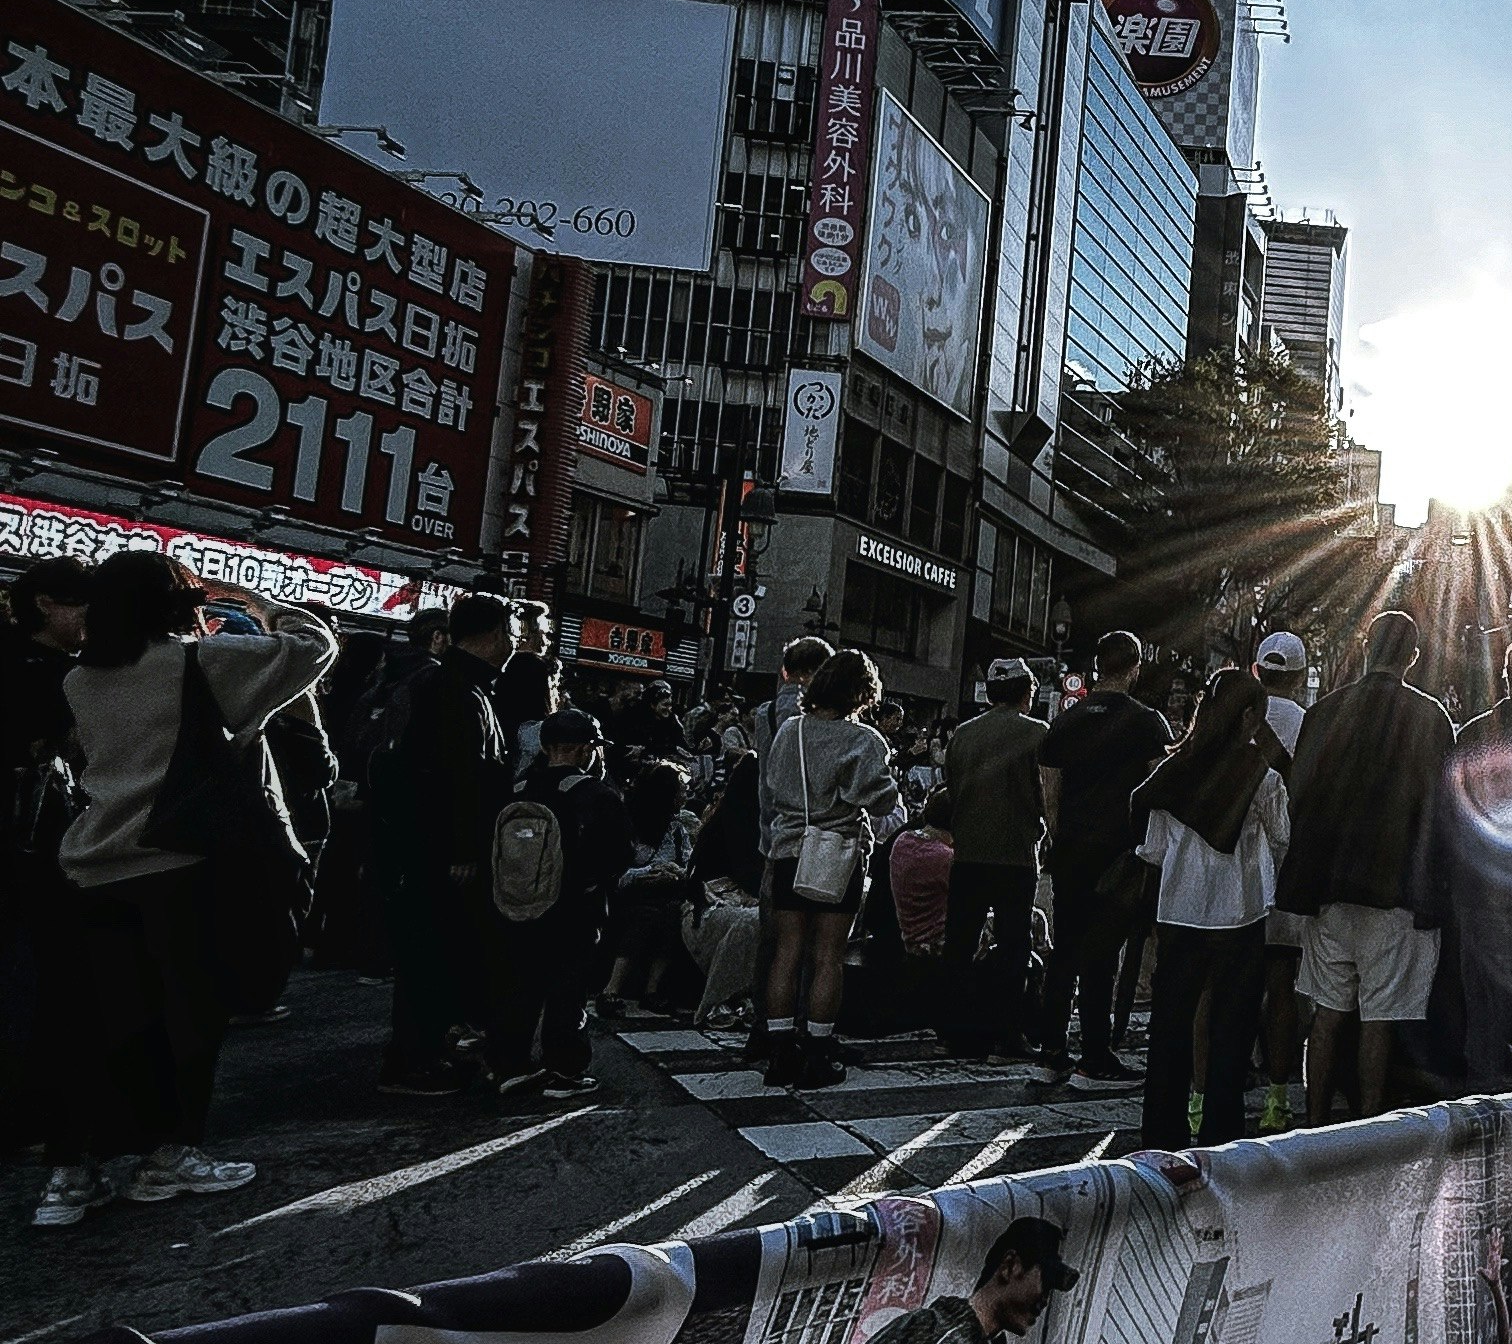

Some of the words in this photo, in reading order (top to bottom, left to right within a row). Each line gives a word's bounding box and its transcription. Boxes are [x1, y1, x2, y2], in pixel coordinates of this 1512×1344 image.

[1114, 12, 1201, 58] 楽園
[1142, 56, 1212, 98] AMUSEMENT
[820, 17, 866, 216] 品川美容外科
[1, 39, 489, 314] 本最大級の超大型店
[0, 241, 175, 356] スパス
[223, 227, 479, 375] エスパス日拓
[217, 294, 474, 432] 渋谷地区合計
[576, 425, 632, 458] SHINOYA
[410, 513, 455, 540] OVER
[859, 535, 922, 577] EXCELSIOR
[924, 561, 957, 590] CAFFÉ
[737, 596, 750, 613] 3
